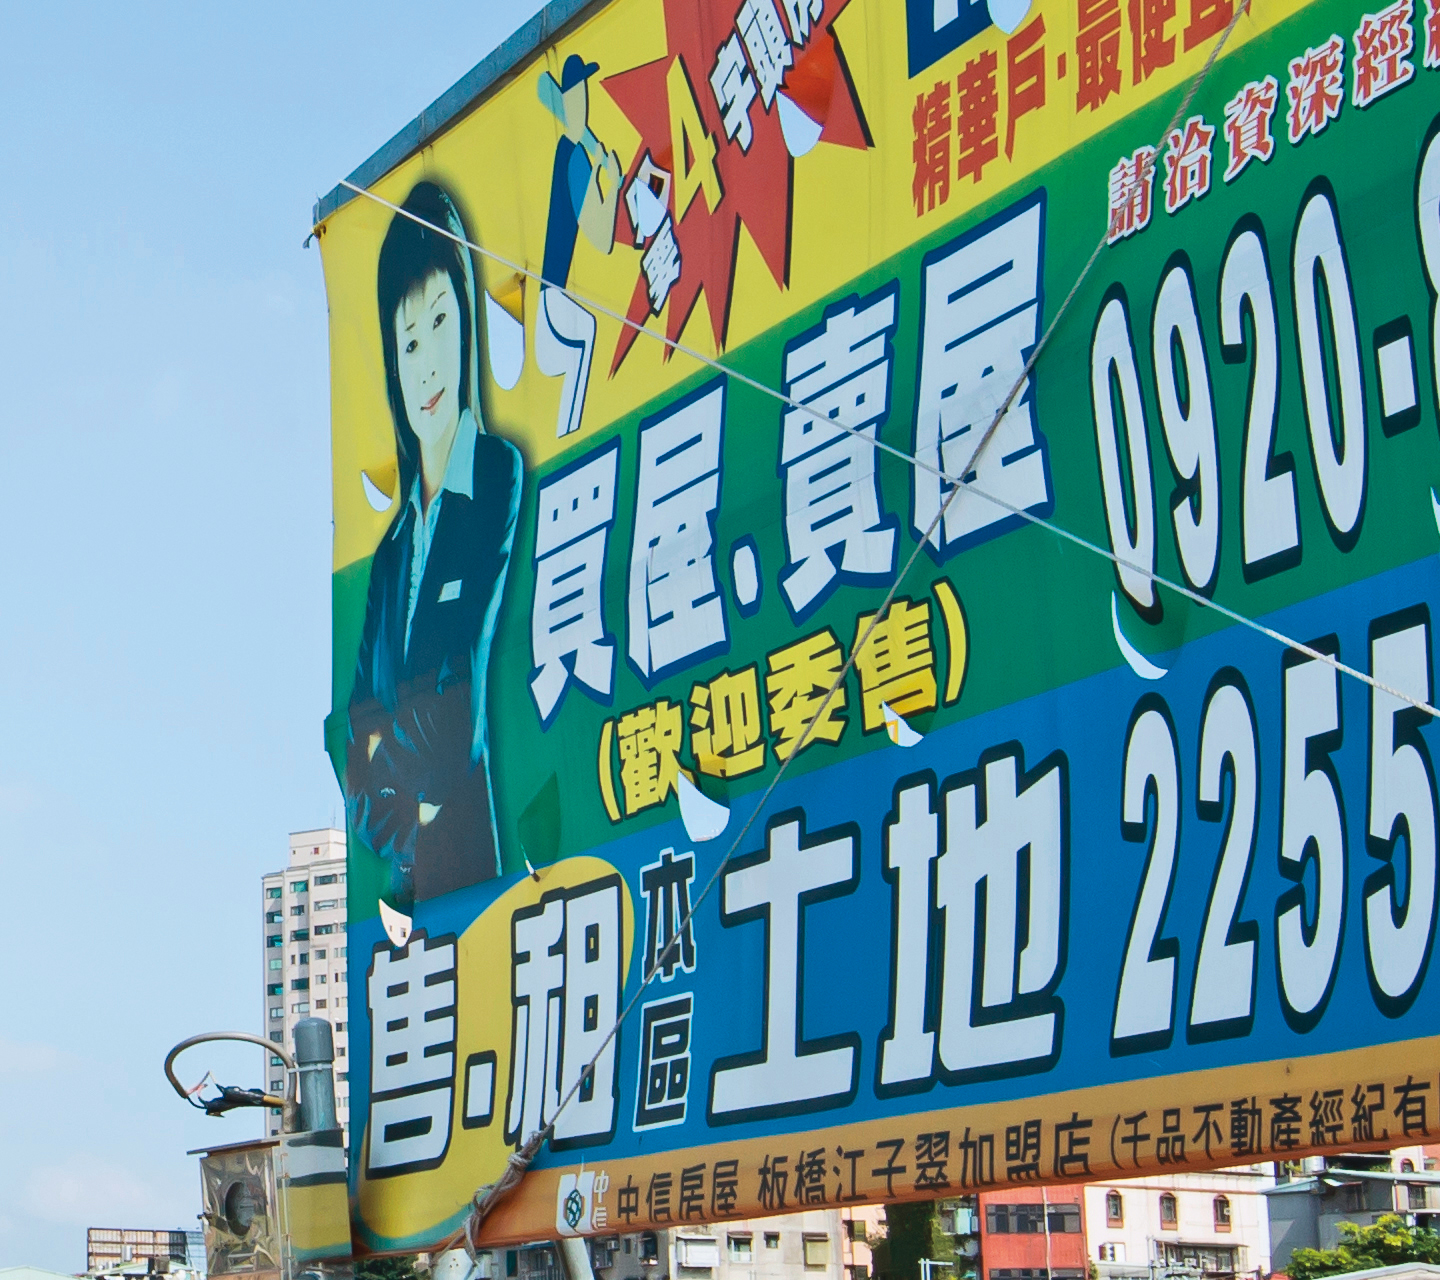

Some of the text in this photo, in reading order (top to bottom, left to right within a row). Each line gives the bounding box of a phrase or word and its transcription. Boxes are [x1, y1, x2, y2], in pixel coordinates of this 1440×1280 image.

[710, 754, 1063, 1117] 土地
[618, 1158, 741, 1222] 中信房屋
